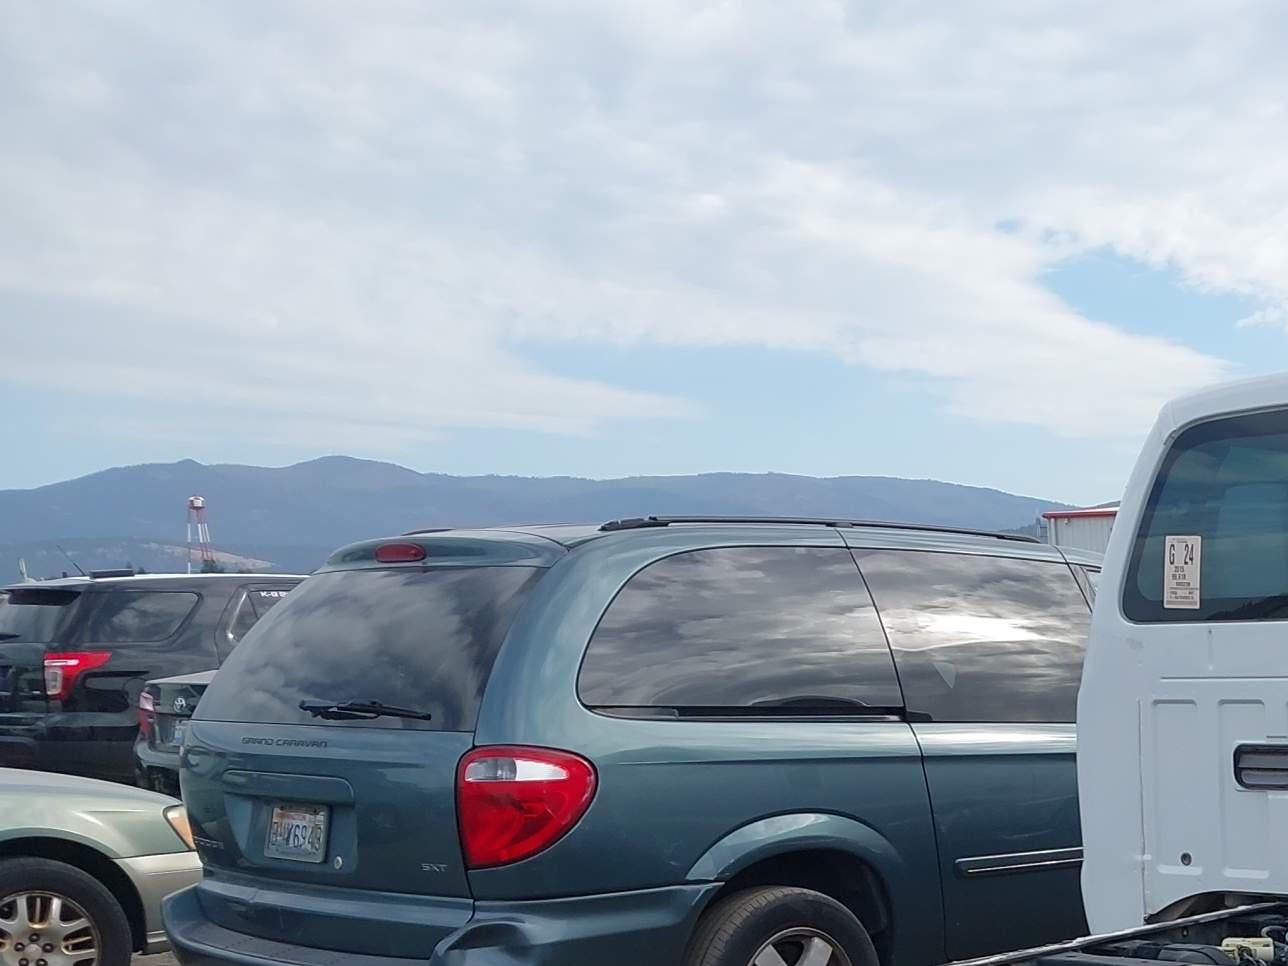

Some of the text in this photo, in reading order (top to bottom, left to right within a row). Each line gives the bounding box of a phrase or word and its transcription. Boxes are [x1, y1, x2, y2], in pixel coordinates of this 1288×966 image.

[1169, 544, 1194, 565] G 24
[241, 736, 329, 749] GRAND CARAVAN
[421, 863, 448, 872] SXT
